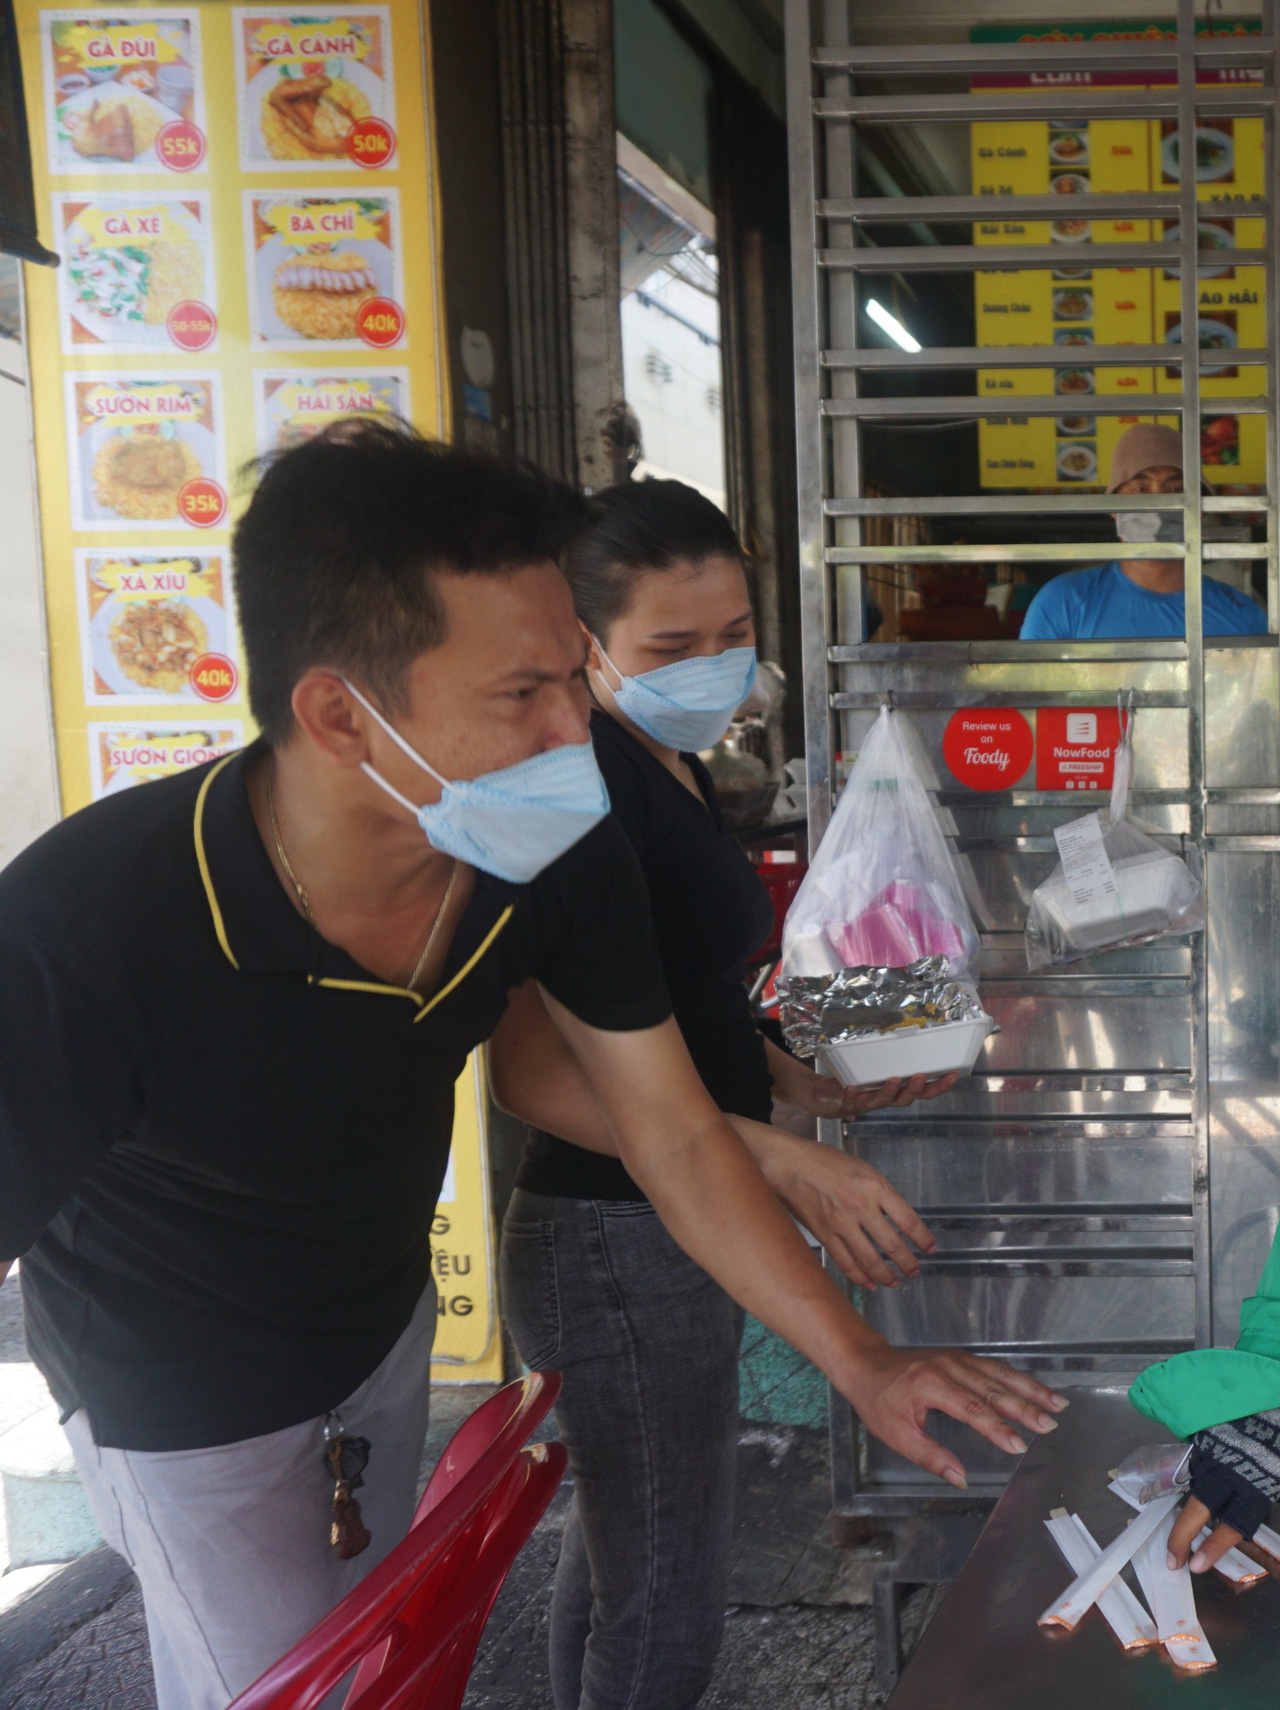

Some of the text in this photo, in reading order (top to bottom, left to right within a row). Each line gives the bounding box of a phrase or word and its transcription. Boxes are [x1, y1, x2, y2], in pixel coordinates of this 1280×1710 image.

[88, 35, 156, 57] GÀ ĐÙI
[267, 32, 355, 55] GÀ CÁNH
[163, 137, 198, 156] 55k
[353, 134, 388, 153] 50k
[105, 212, 160, 234] GÀ XÉ
[290, 207, 354, 231] BA CHỈ
[362, 313, 398, 331] 40k
[157, 397, 191, 413] RIM
[297, 388, 374, 411] HẢI SẢN
[120, 571, 186, 591] XÁ XÍU
[196, 669, 232, 687] 40k
[962, 720, 1012, 731] Review us
[980, 735, 993, 744] on
[963, 747, 1010, 771] Foody
[1053, 746, 1110, 758] NowFood
